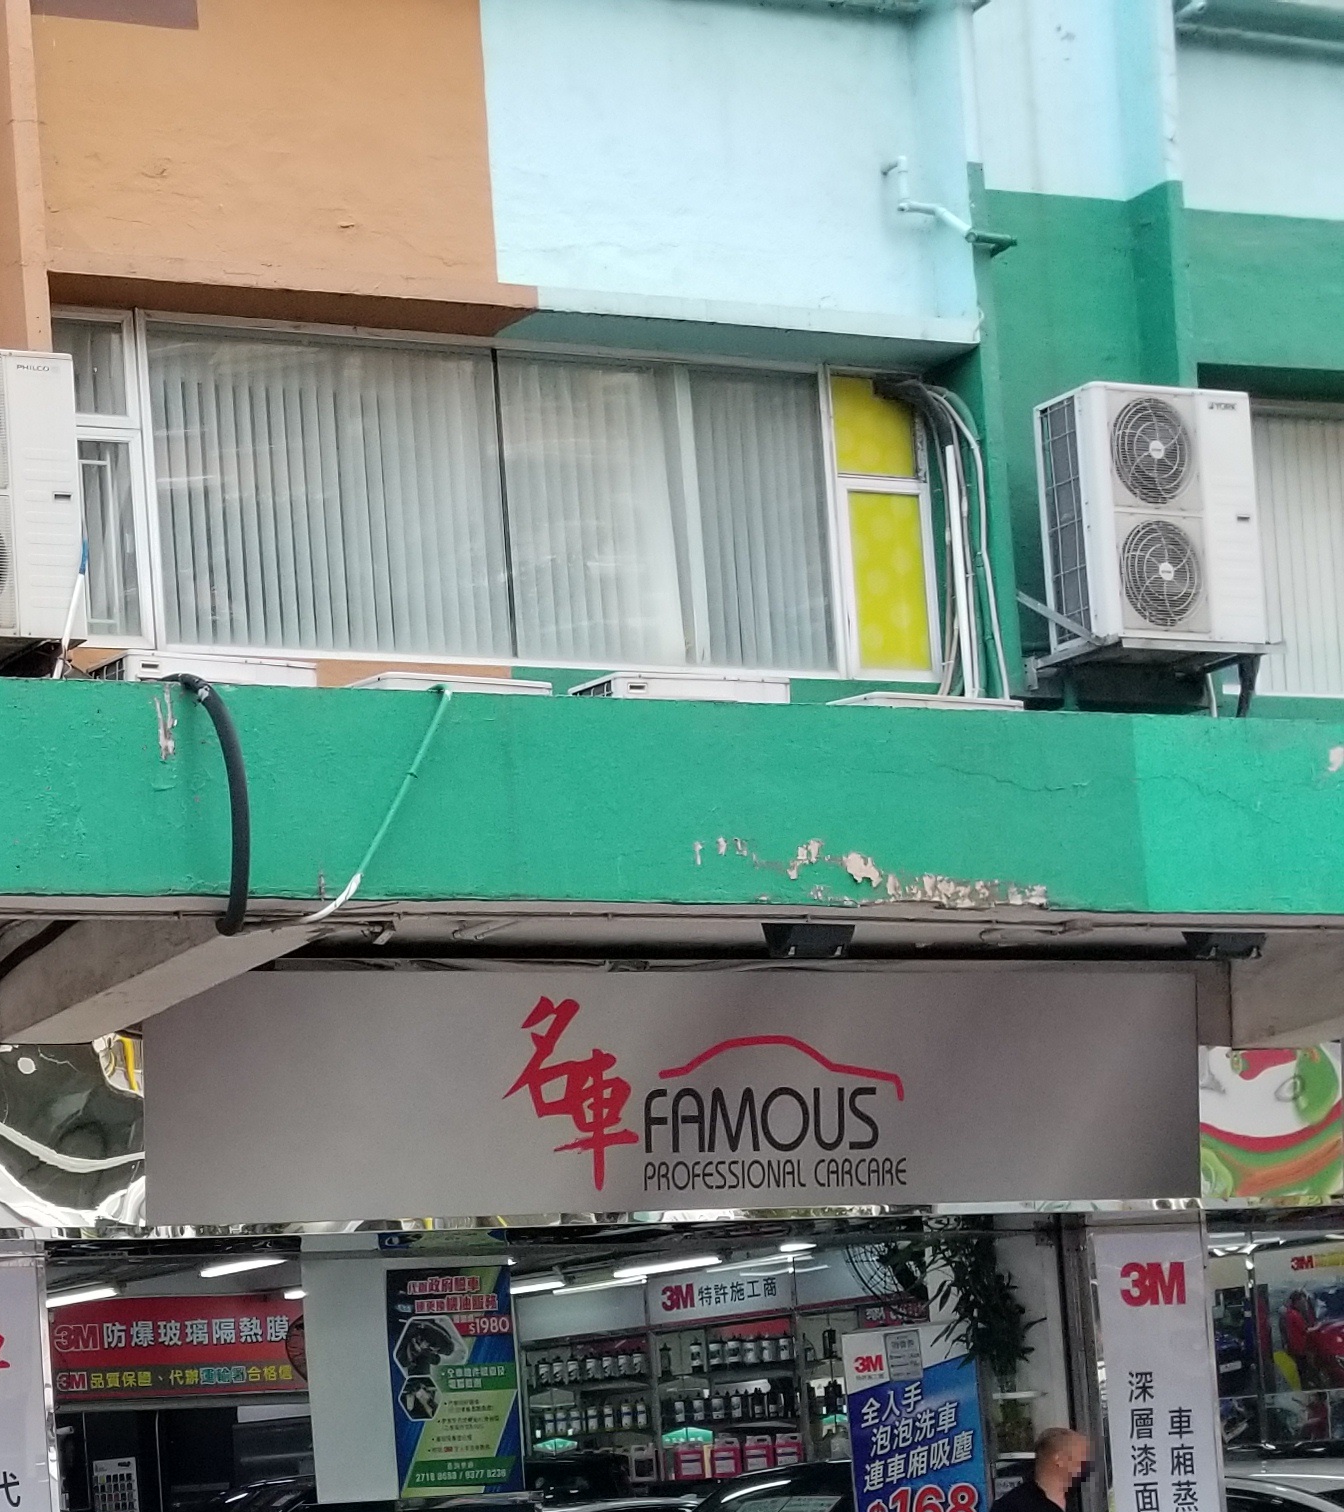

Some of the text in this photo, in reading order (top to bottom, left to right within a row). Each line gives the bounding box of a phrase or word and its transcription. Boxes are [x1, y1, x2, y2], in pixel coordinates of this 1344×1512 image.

[502, 995, 639, 1191] 名車
[644, 1086, 881, 1154] FAMOUS
[643, 1156, 908, 1191] PROFESSIONAL CARCARE
[661, 1277, 777, 1312] 3M 特許施工商
[1120, 1261, 1187, 1307] 3M
[54, 1324, 100, 1352] 3M
[469, 1316, 510, 1335] $1980
[56, 1371, 87, 1391] 3M
[854, 1354, 884, 1373] 3M
[870, 1402, 958, 1457] 泡泡洗車
[863, 1430, 974, 1493] 連車廂吸塵
